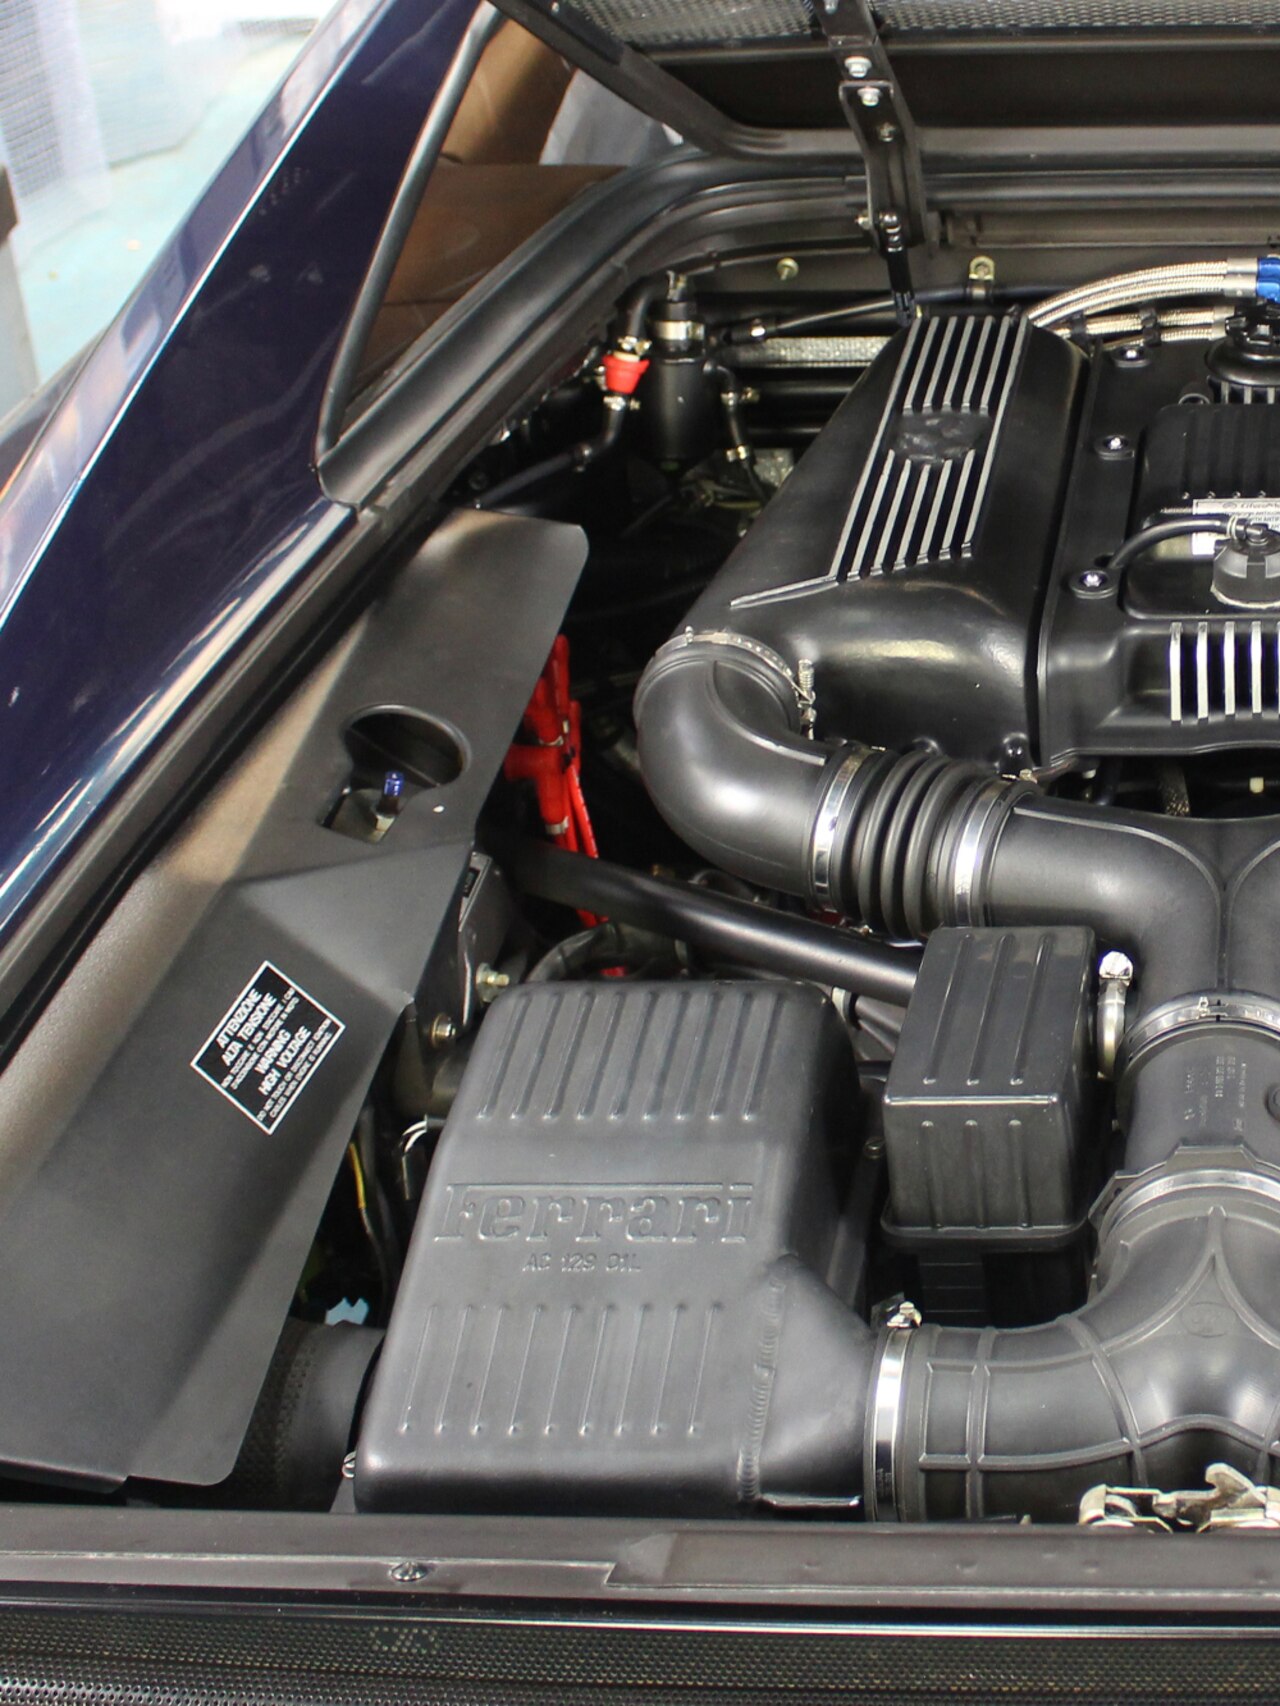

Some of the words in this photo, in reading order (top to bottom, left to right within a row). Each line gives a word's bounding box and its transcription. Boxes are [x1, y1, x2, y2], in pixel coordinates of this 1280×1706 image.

[215, 988, 262, 1048] ATTENZIONE
[221, 1040, 243, 1066] ALTA
[236, 992, 277, 1040] TENSIONE
[275, 1025, 311, 1068] VOLTAGE
[253, 1028, 291, 1074] WARNING
[435, 1183, 754, 1243] Ferrari
